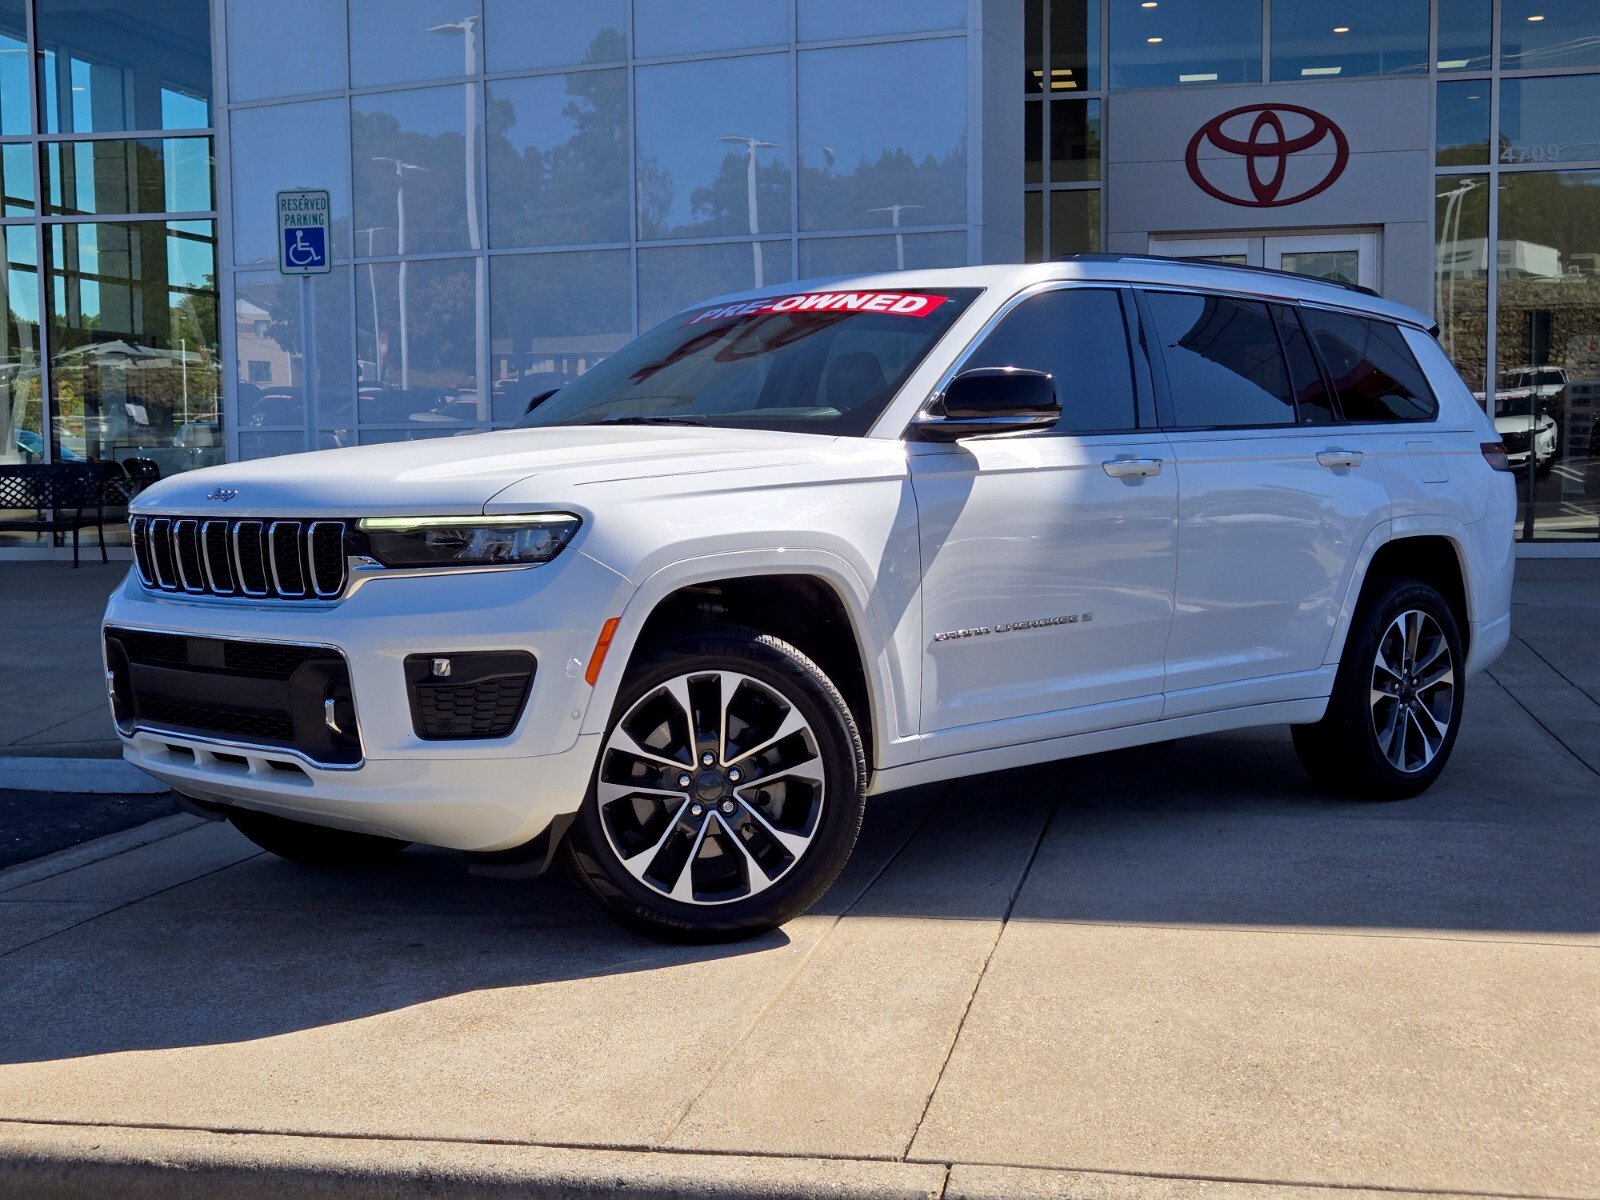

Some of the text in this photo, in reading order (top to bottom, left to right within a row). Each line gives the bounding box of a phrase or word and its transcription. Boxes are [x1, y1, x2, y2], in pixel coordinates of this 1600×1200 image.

[1501, 144, 1559, 162] 4709
[281, 198, 327, 211] RESERVED
[284, 213, 325, 226] PARKING
[690, 293, 928, 325] PRE-OWNED
[207, 486, 239, 502] Jeep
[933, 626, 991, 642] GRAND
[995, 614, 1078, 633] CHEROKEE
